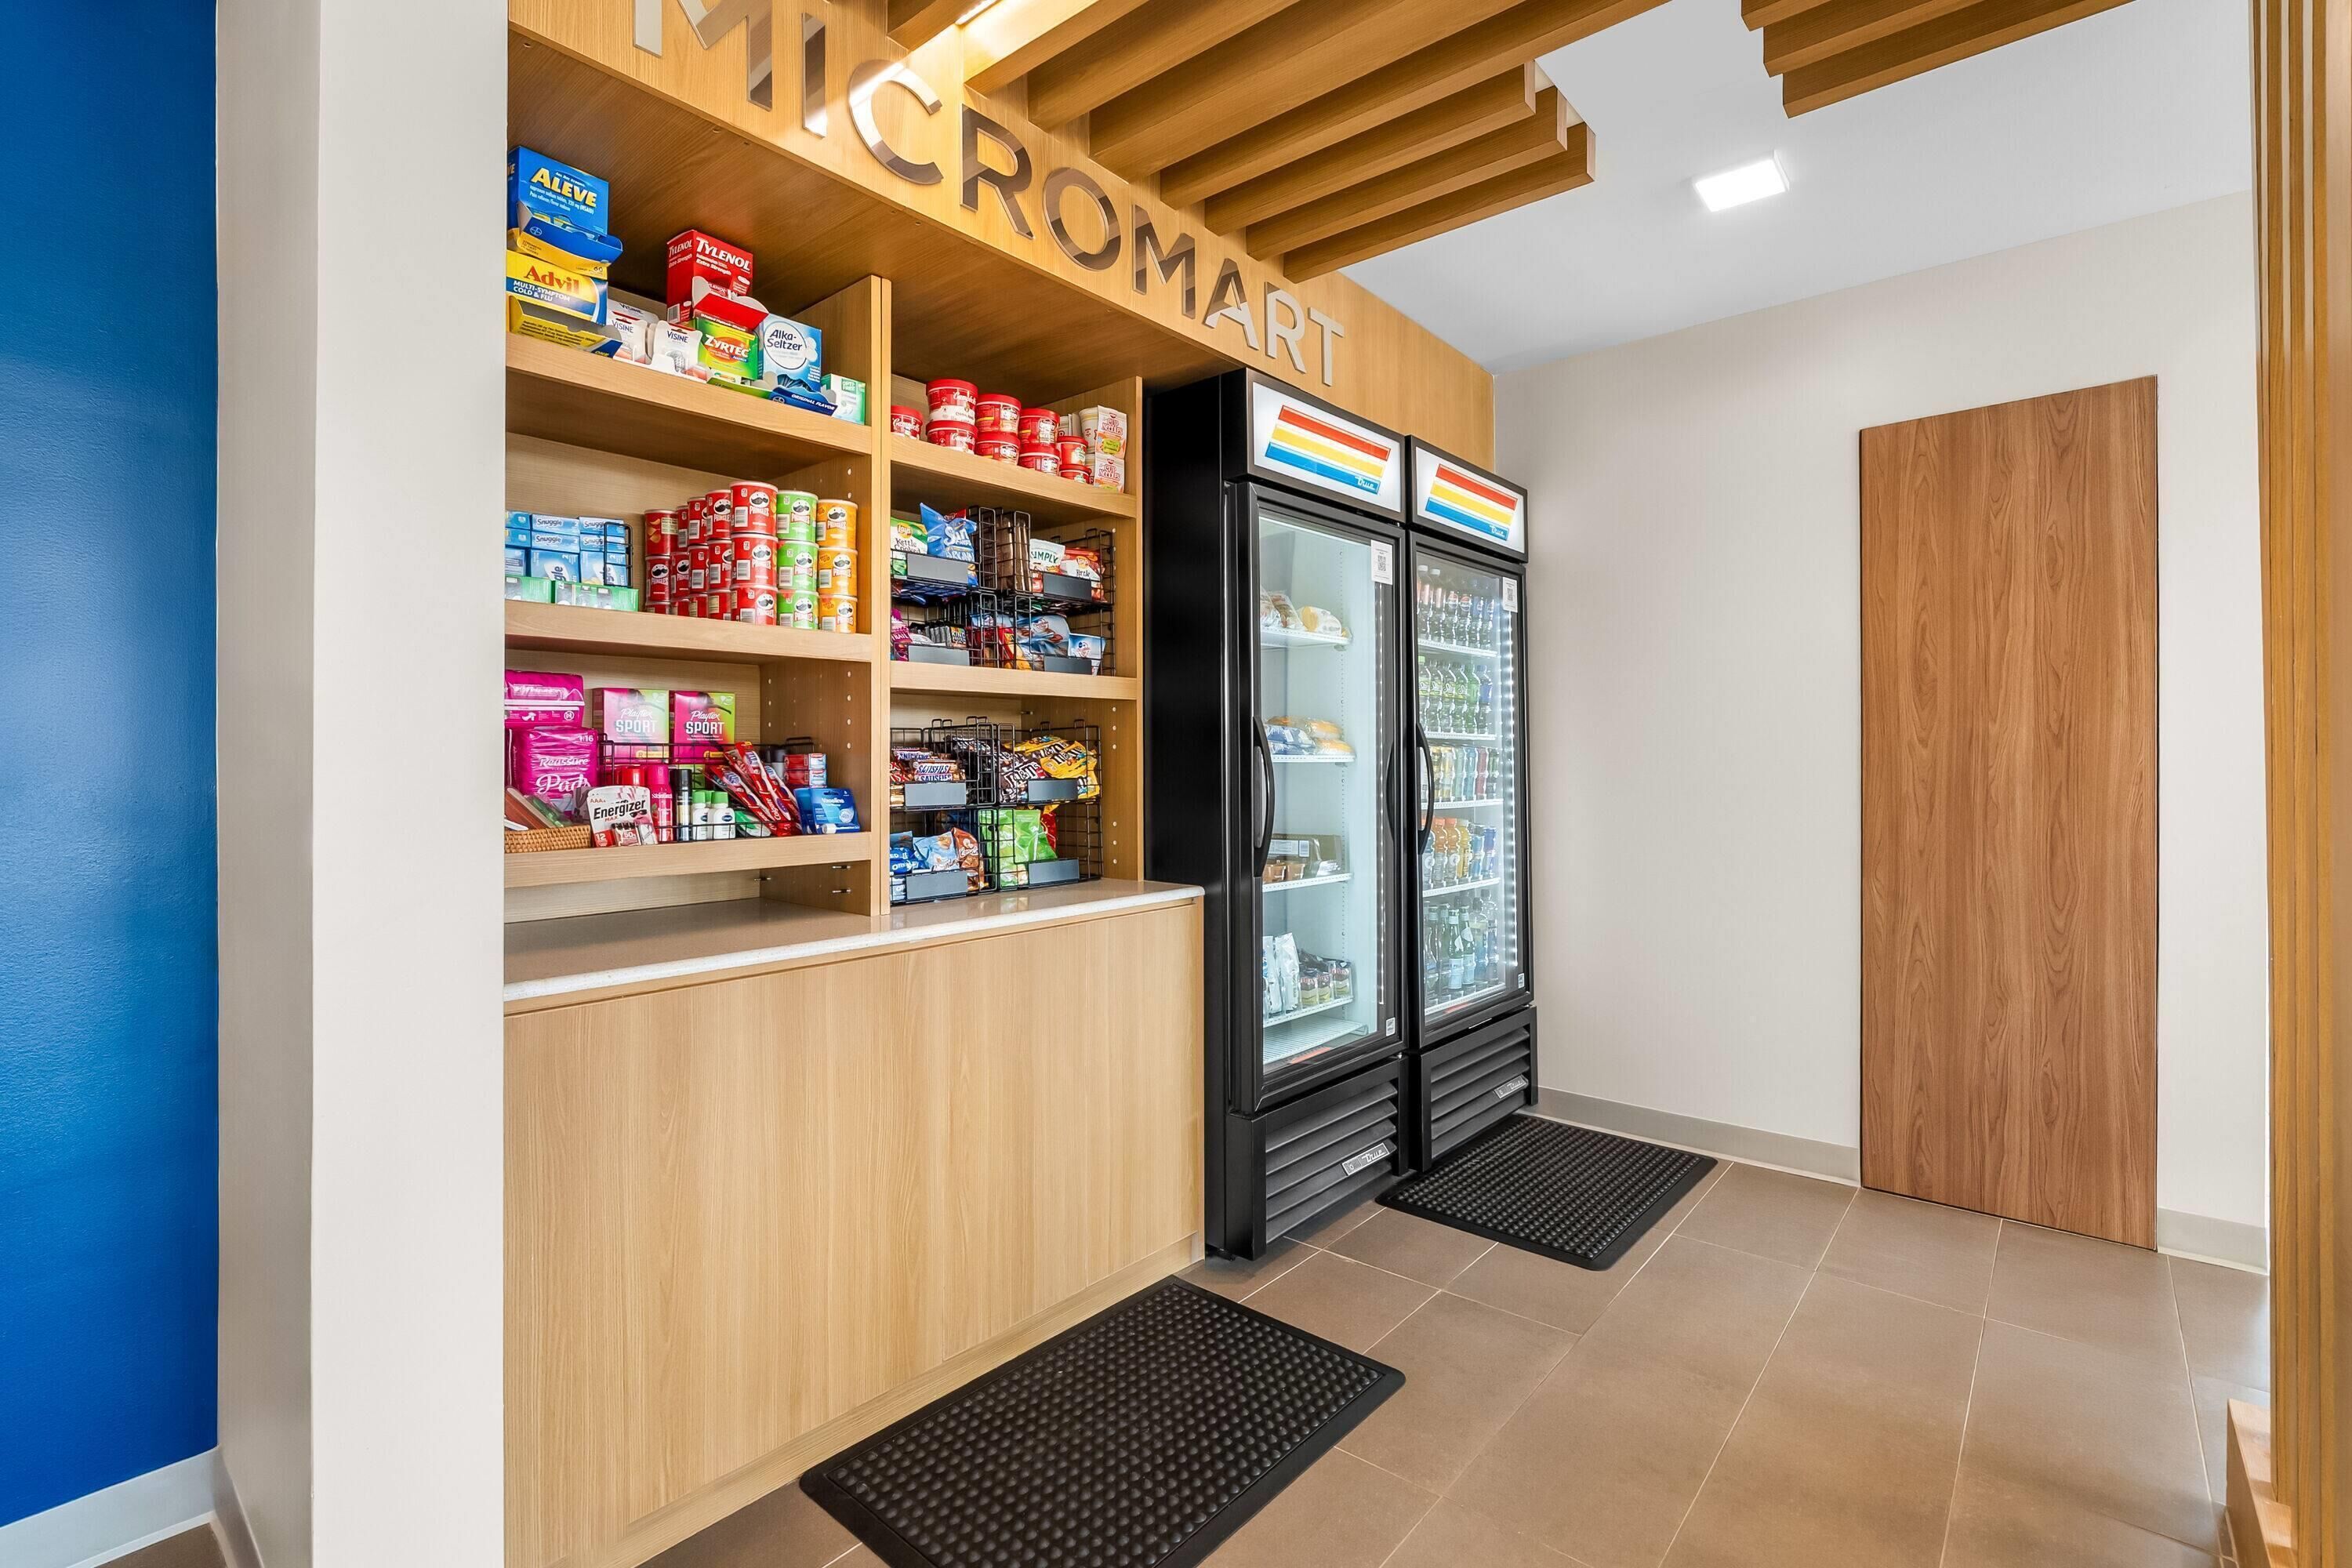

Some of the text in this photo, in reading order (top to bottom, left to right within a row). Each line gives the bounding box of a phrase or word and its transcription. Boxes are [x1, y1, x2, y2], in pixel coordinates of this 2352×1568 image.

[531, 167, 597, 208] ALEVE
[633, 0, 1345, 387] MICROMART
[669, 239, 693, 258] TYLENOL
[695, 237, 750, 271] TYLENOL
[524, 266, 579, 294] Advil
[514, 280, 571, 302] MULTI-SYMPTOM
[514, 286, 532, 296] COLD
[540, 293, 554, 302] FLU
[612, 319, 634, 333] VISINE
[666, 330, 688, 343] VISINE
[769, 329, 797, 342] Alka-
[704, 334, 750, 358] ZYRTEC
[767, 338, 803, 351] Seltzer
[791, 394, 836, 411] ORIGINAL FLAVOR
[537, 518, 562, 527] Snuggle
[535, 535, 561, 545] Snuggle
[895, 538, 917, 547] Kettle
[620, 708, 653, 720] Playtex
[691, 710, 720, 722] Playtex
[615, 720, 657, 733] SPORT
[685, 721, 724, 735] SPORT
[539, 755, 589, 768] Reassure
[593, 800, 646, 820] Energizer
